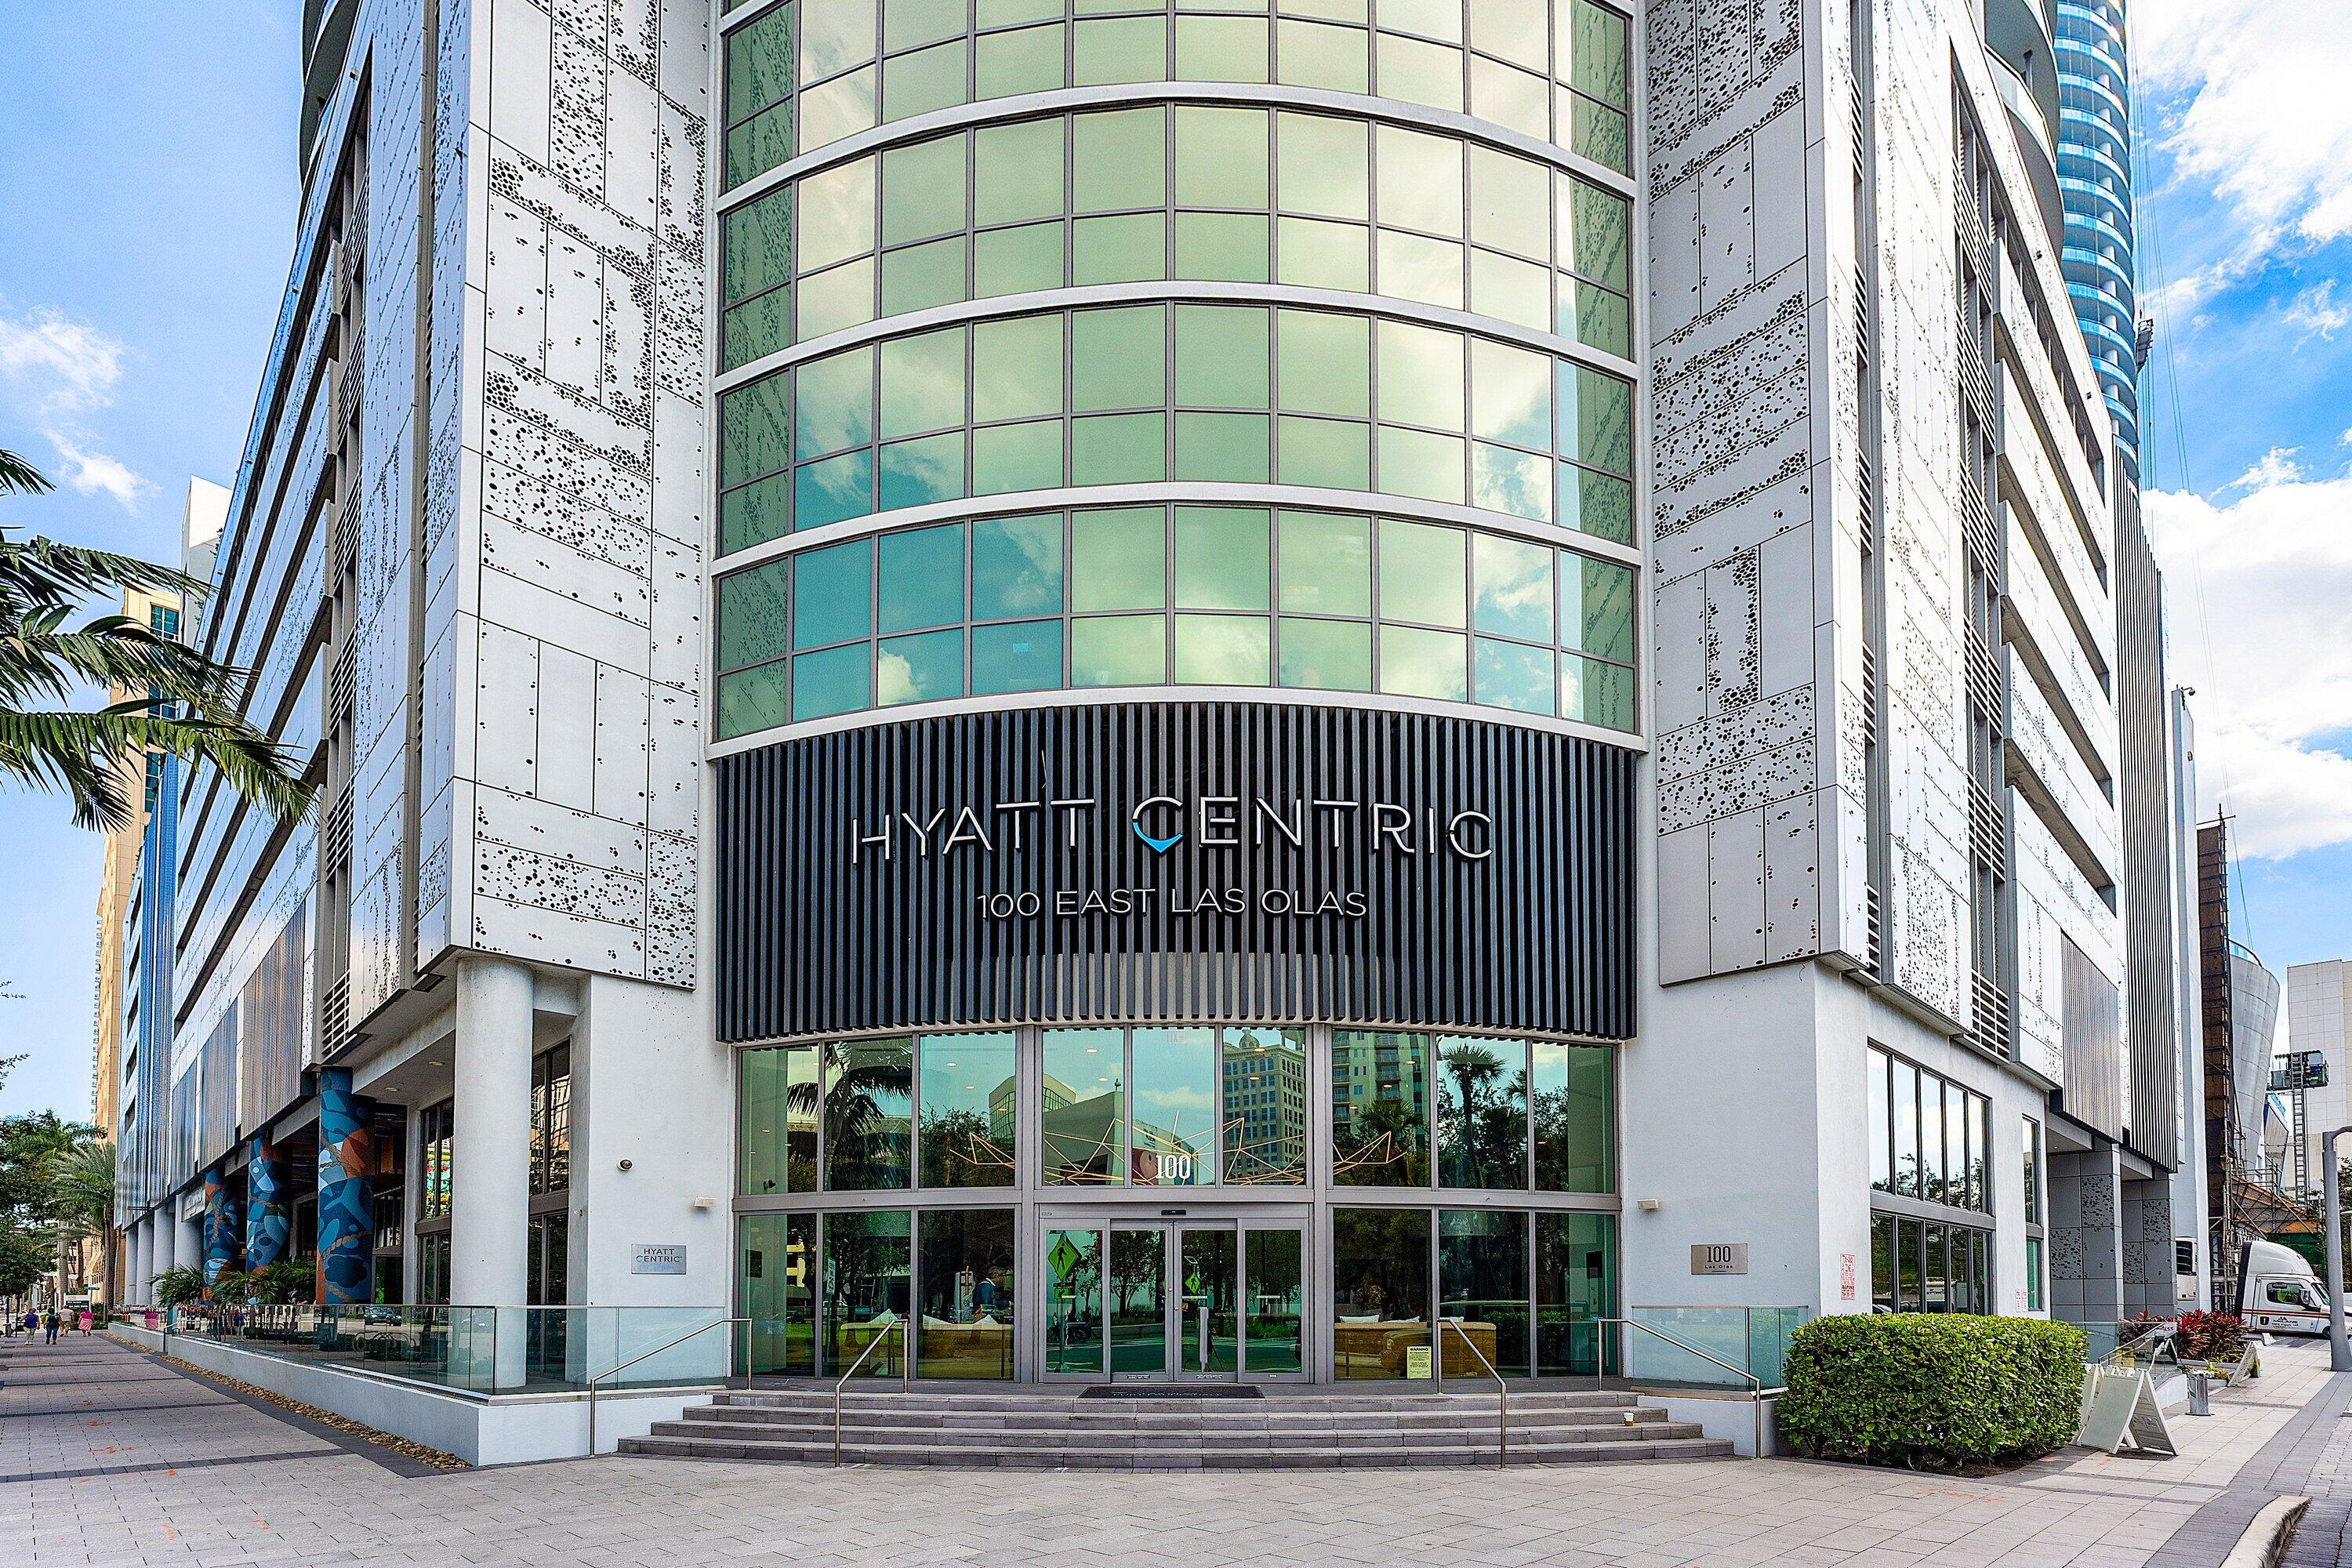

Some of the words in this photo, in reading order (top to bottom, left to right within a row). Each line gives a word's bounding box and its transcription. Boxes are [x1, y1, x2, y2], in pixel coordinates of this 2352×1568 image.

[852, 798, 1096, 865] HYATT
[1131, 796, 1494, 859] CENTRIC
[977, 891, 1040, 919] 100
[1056, 887, 1156, 915] EAST
[1171, 887, 1247, 913] LAS
[1261, 888, 1367, 916] OLAS
[1155, 1154, 1191, 1179] 100
[1706, 1246, 1731, 1263] 100
